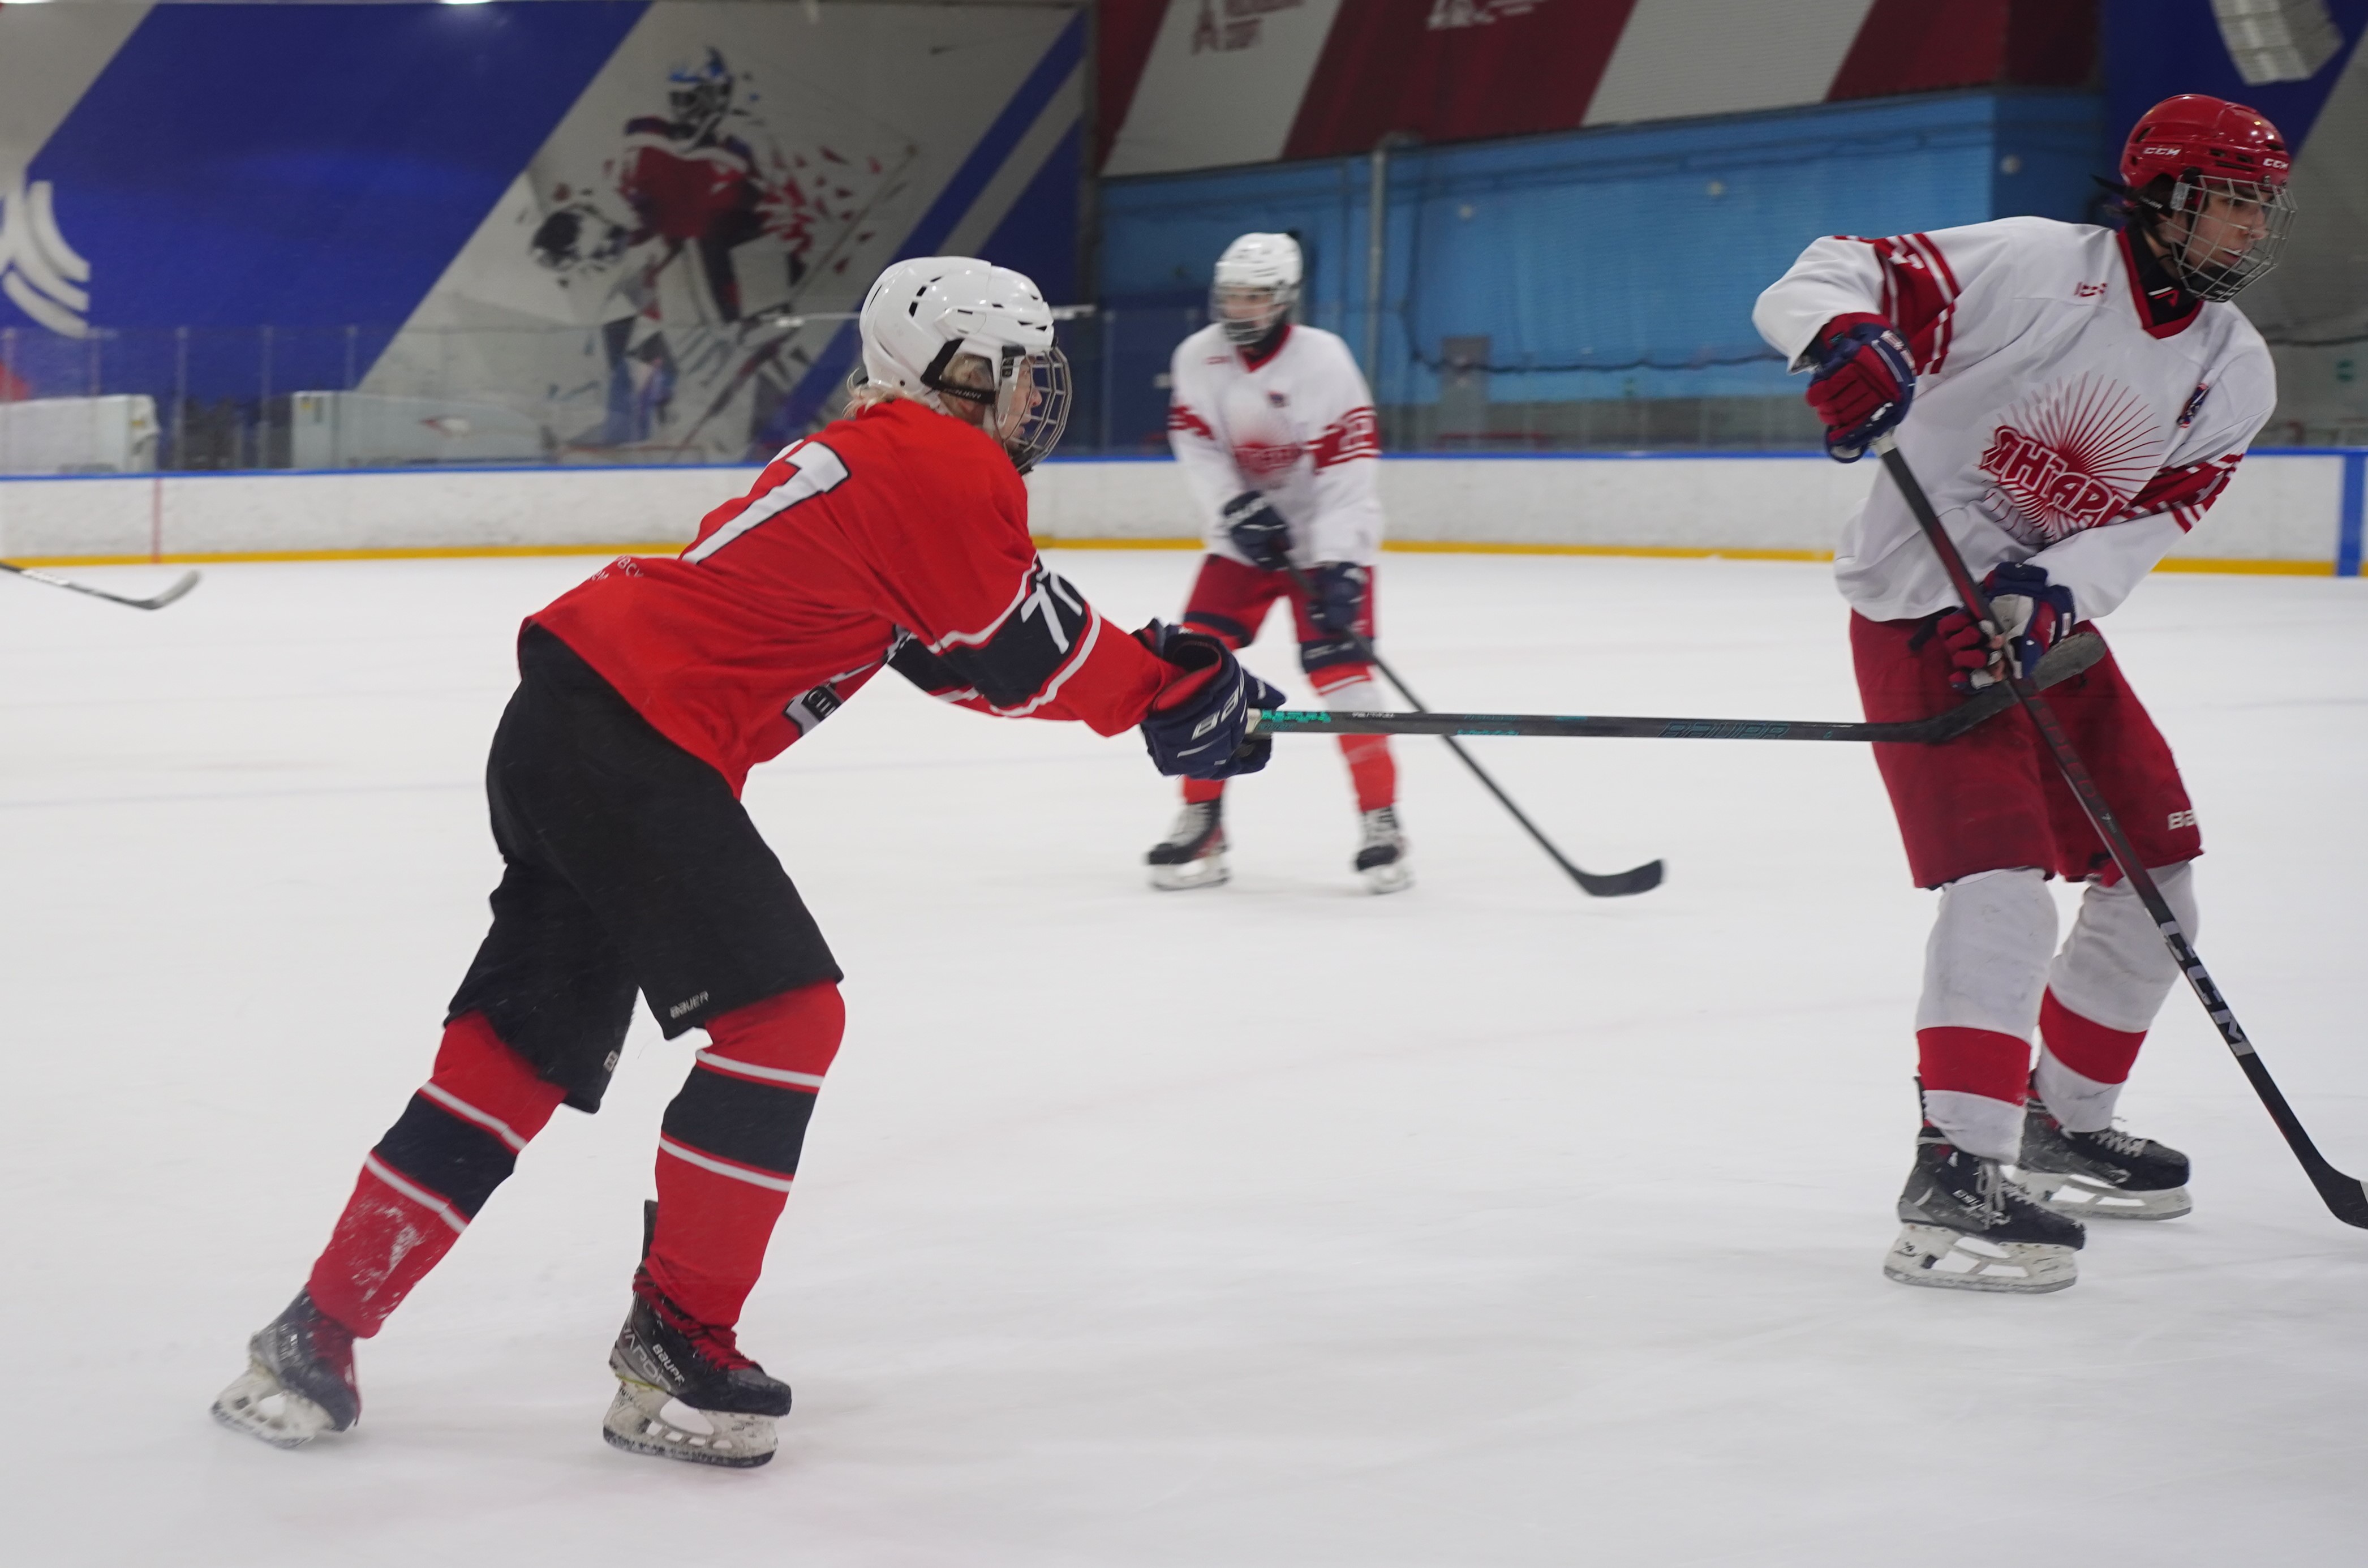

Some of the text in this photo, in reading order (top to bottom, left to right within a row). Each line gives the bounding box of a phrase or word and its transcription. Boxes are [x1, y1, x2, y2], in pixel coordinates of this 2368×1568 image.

[2143, 147, 2182, 156] CCM
[2263, 158, 2289, 170] CCM
[682, 439, 850, 565] 7
[1657, 720, 1791, 740] BAUER
[2160, 920, 2256, 1056] CCM
[669, 991, 709, 1019] BAUER
[652, 1343, 685, 1386] BAUER
